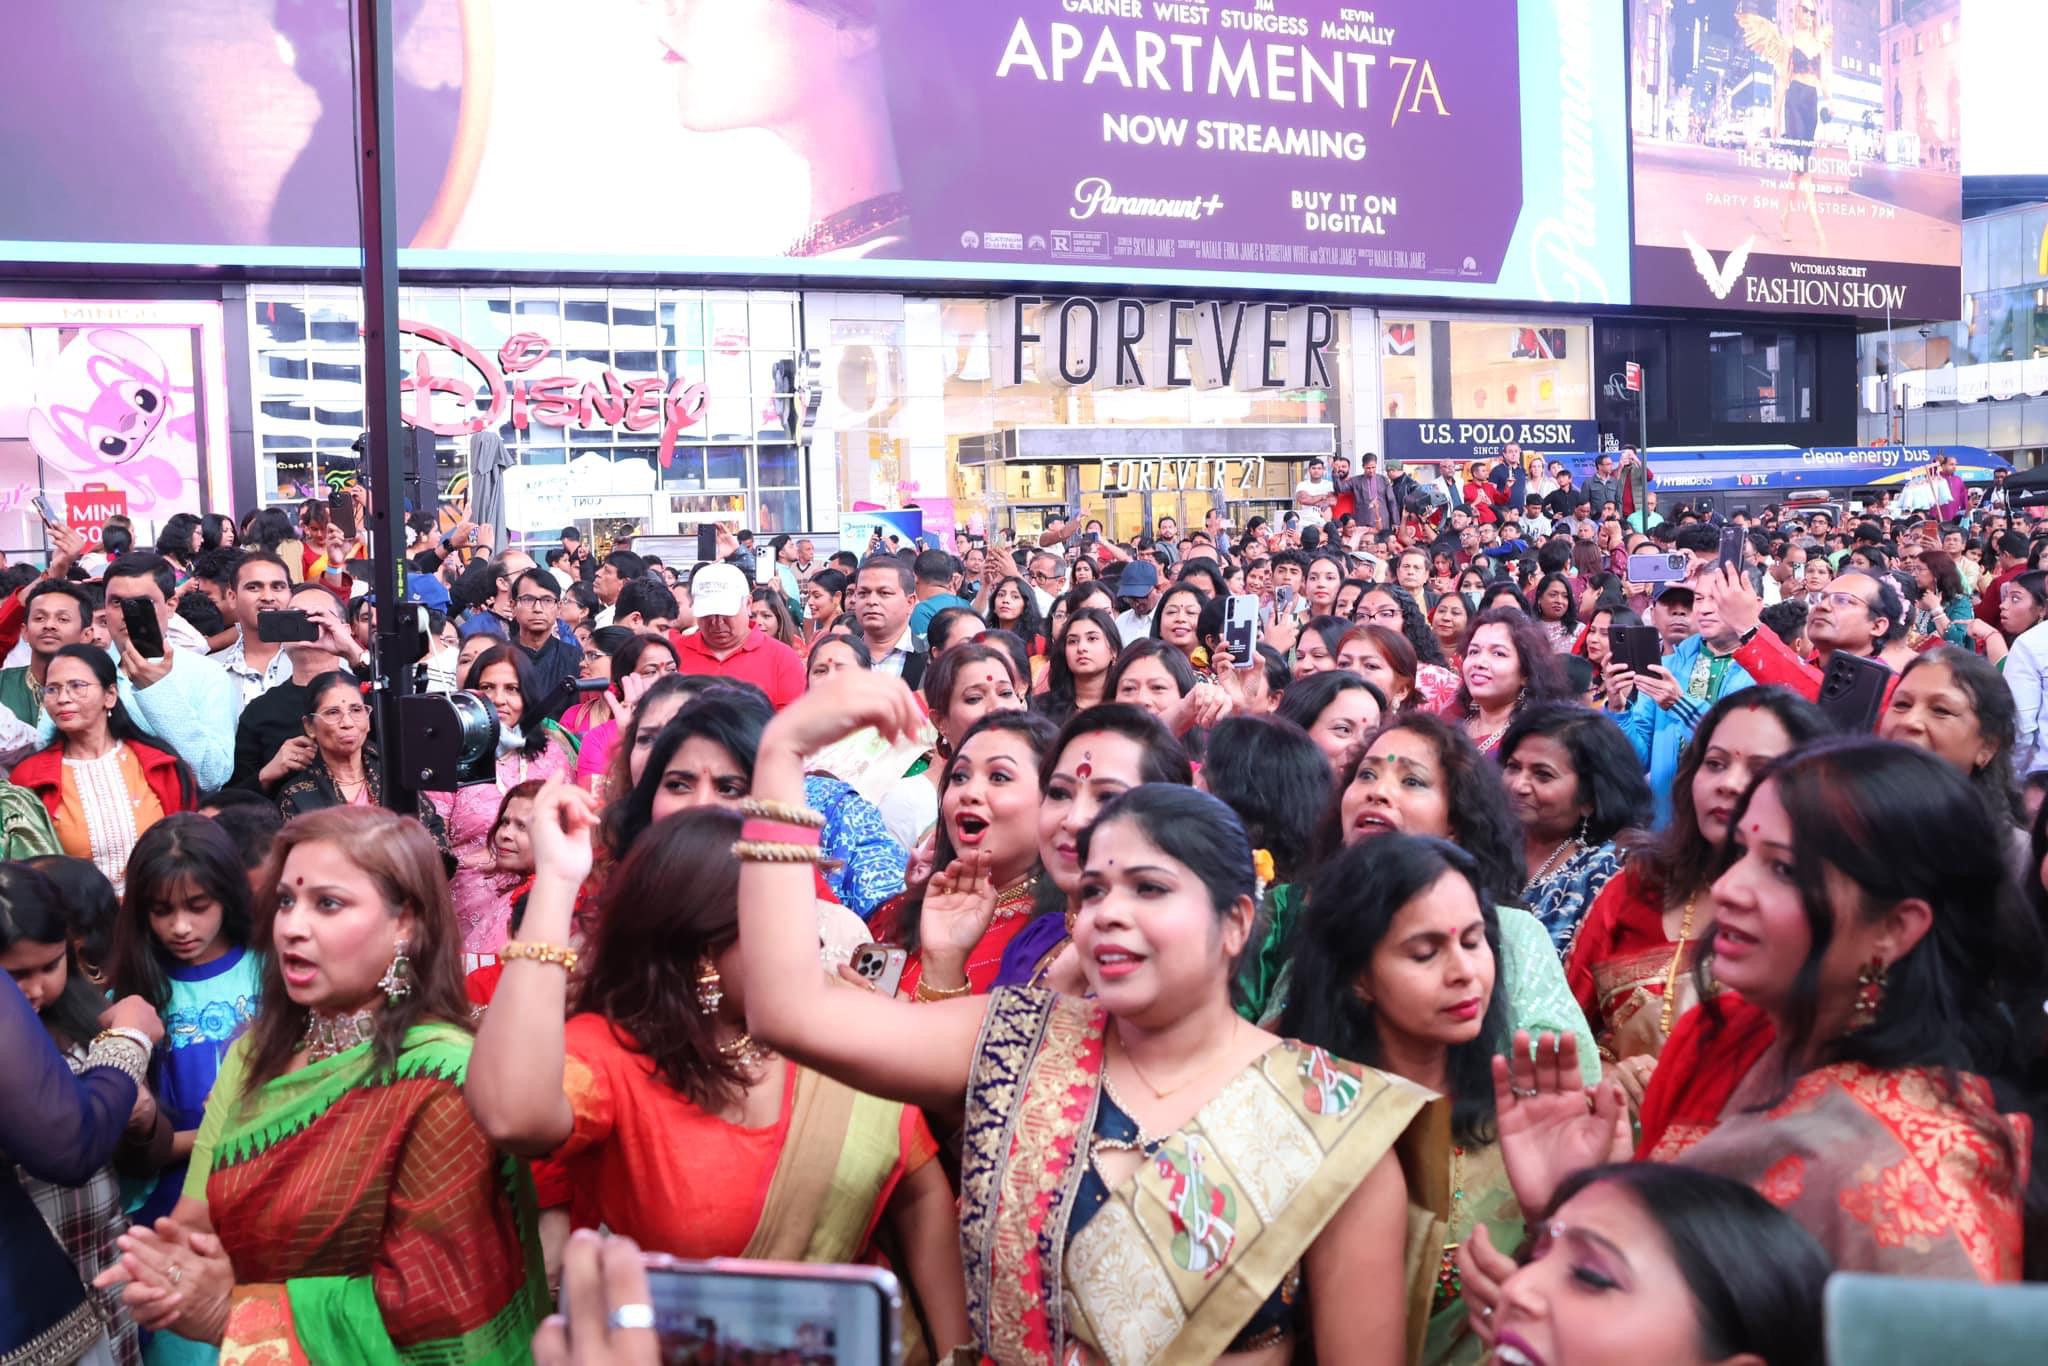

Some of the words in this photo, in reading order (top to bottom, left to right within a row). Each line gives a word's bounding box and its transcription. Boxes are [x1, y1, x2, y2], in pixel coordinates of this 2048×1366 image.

[1062, 0, 1143, 19] GARNER
[1154, 4, 1211, 26] WIEST
[1220, 9, 1309, 36] STURGESS
[1320, 21, 1396, 46] McNALLY
[1340, 8, 1375, 24] KEVIN
[995, 17, 1376, 108] APARTMENT
[1388, 56, 1451, 128] 7A
[1102, 112, 1188, 147] NOW
[1196, 120, 1367, 160] STREAMING
[1736, 149, 1762, 169] THE
[1766, 152, 1804, 172] PENN
[1808, 156, 1865, 178] DISTRICT
[1070, 177, 1224, 220] Paramount+
[1291, 190, 1333, 212] BUY
[1340, 193, 1358, 213] IT
[1363, 195, 1397, 216] ON
[1706, 192, 1747, 207] PARTY
[1754, 195, 1779, 210] 5PM
[1790, 200, 1866, 217] LIVESTREAM
[1871, 203, 1895, 220] 7PM
[1305, 213, 1386, 236] DIGITAL
[1790, 262, 1836, 277] VICTORIA'S
[1837, 264, 1867, 279] SECRET
[1746, 276, 1841, 307] FASHION
[1843, 280, 1906, 310] SHOW
[1014, 295, 1333, 388] FOREVER
[1419, 423, 1455, 444] U.S.
[1459, 423, 1514, 445] POLO
[1518, 424, 1575, 445] ASSN.
[1473, 446, 1499, 456] SINCE
[1802, 448, 1900, 467] clean-energy
[1904, 446, 1931, 462] bus
[1099, 459, 1226, 492] FOREVER
[1239, 457, 1266, 489] 21
[73, 503, 122, 522] MINI
